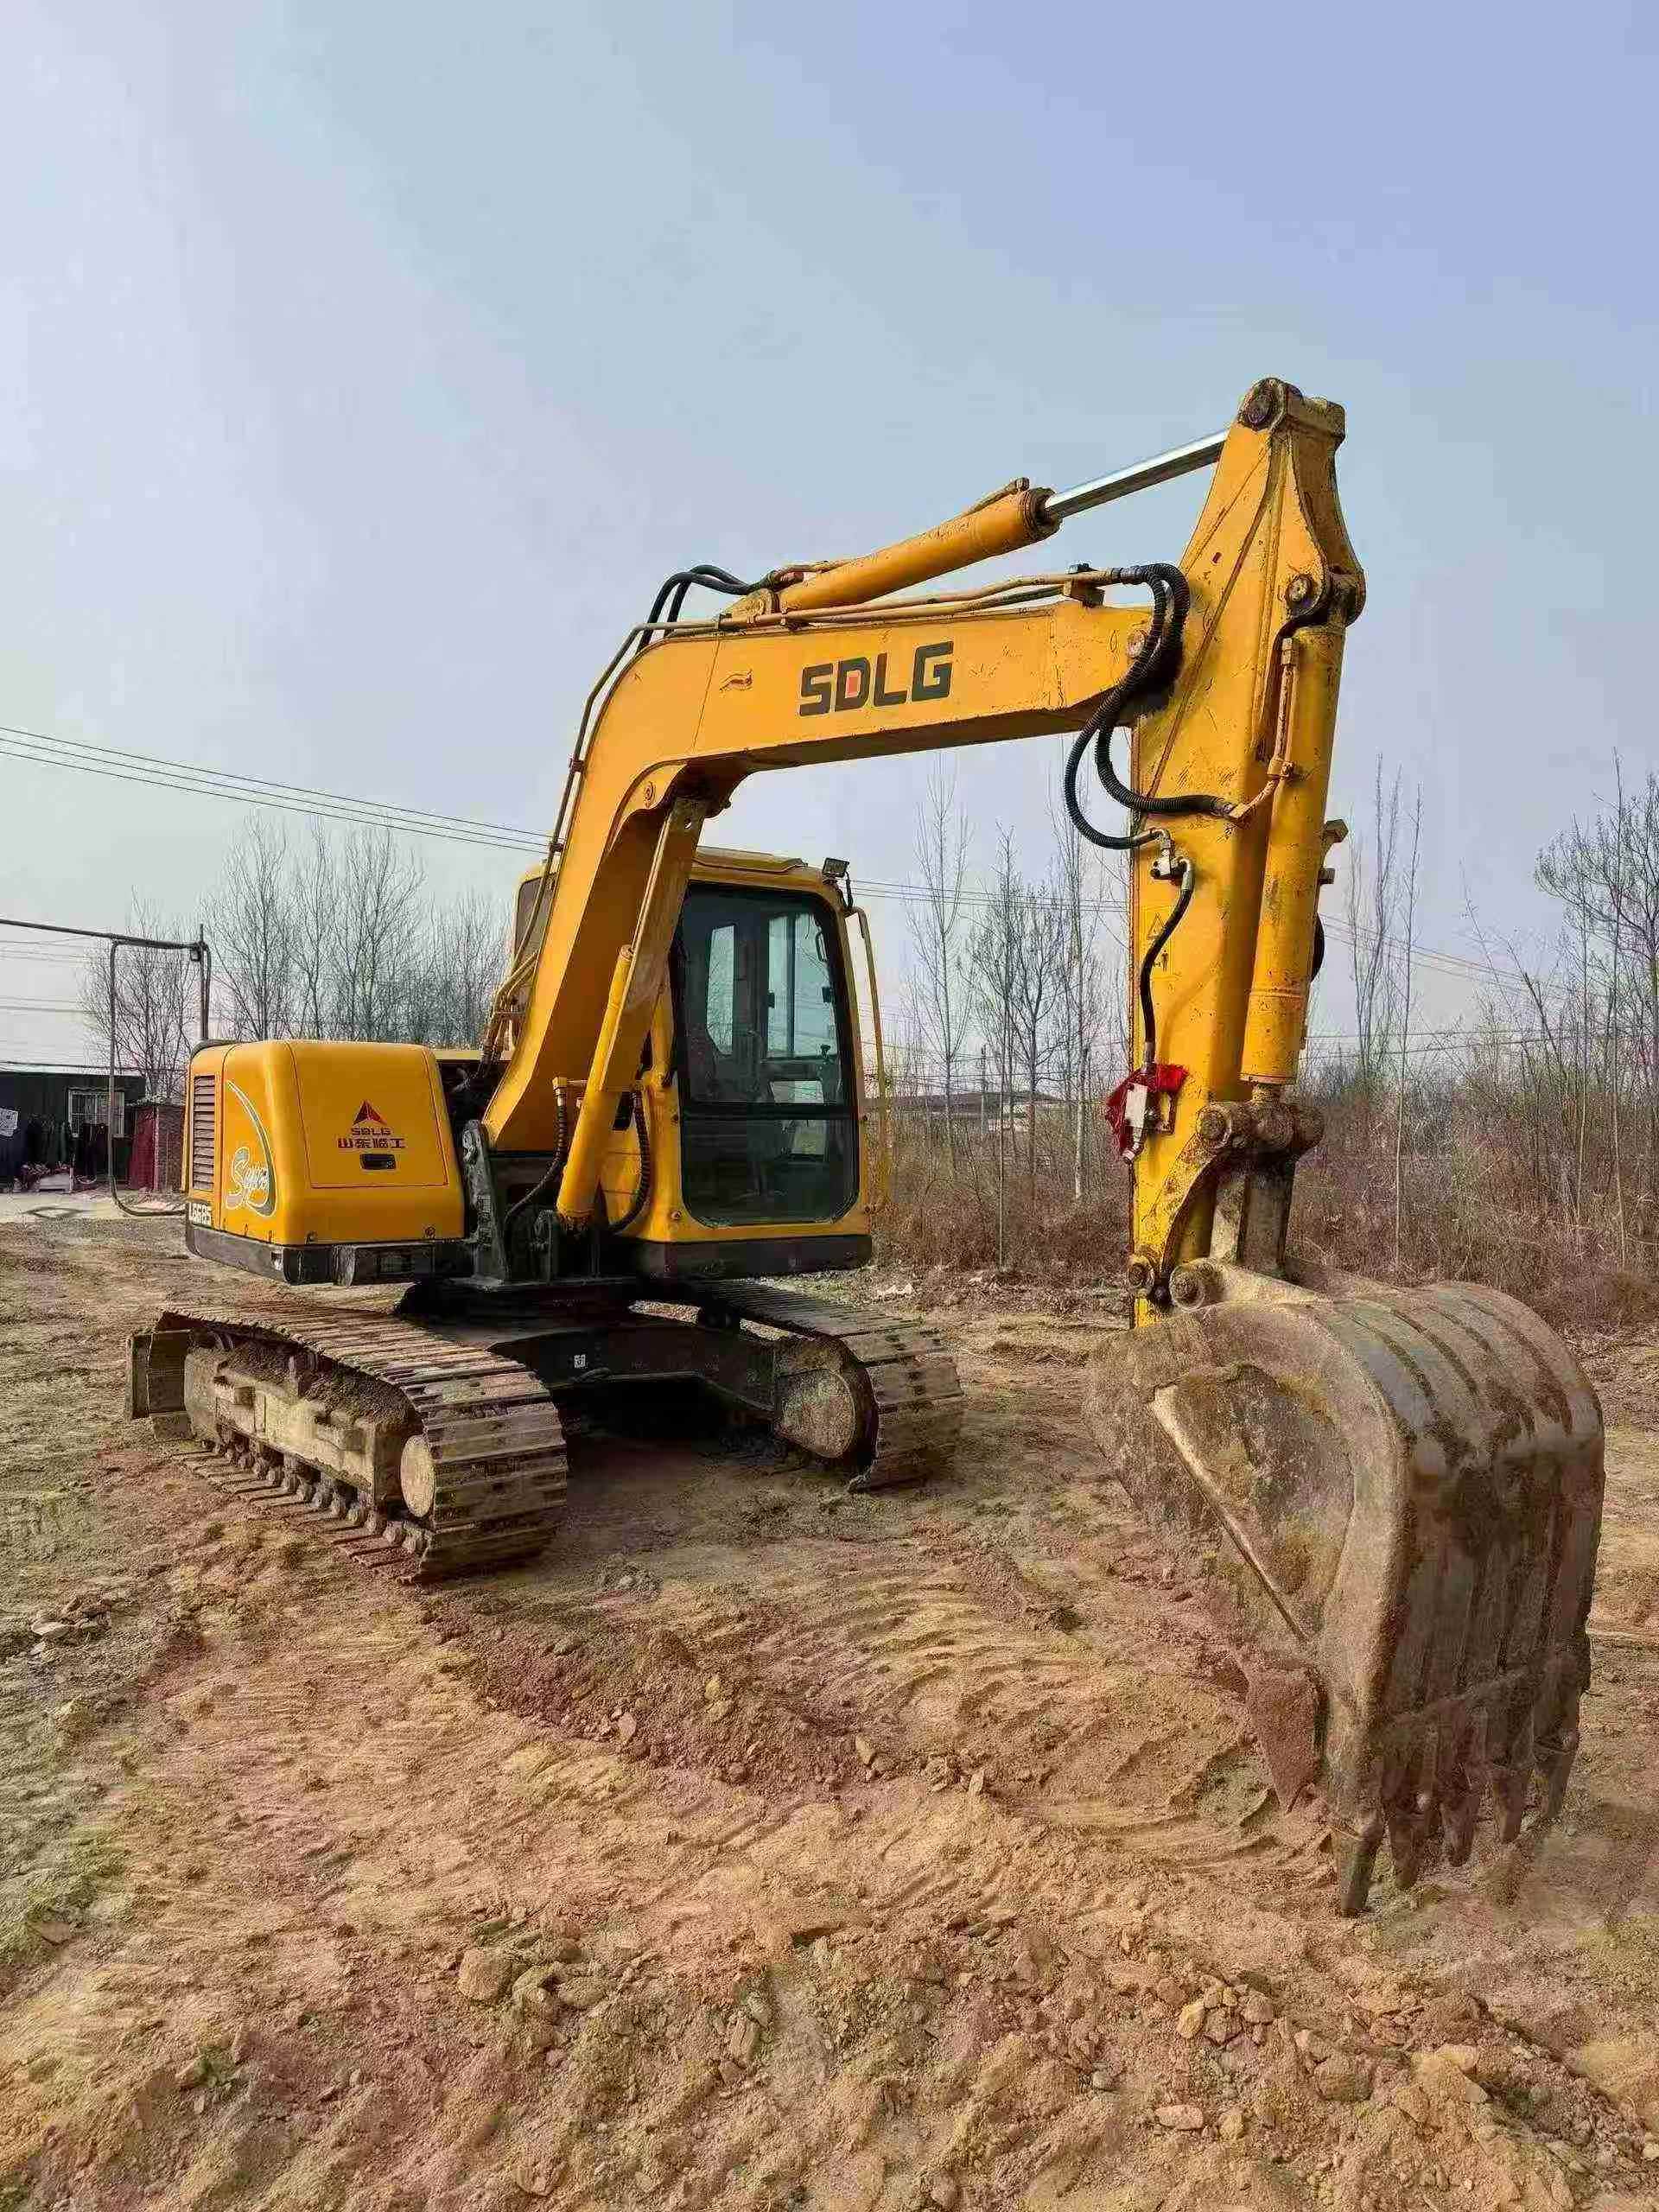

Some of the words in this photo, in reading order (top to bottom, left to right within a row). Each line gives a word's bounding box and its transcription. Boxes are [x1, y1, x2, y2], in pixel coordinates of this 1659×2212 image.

[799, 640, 954, 716] SDLG
[351, 1127, 392, 1136] SDLG
[337, 1137, 407, 1148] 山东临工
